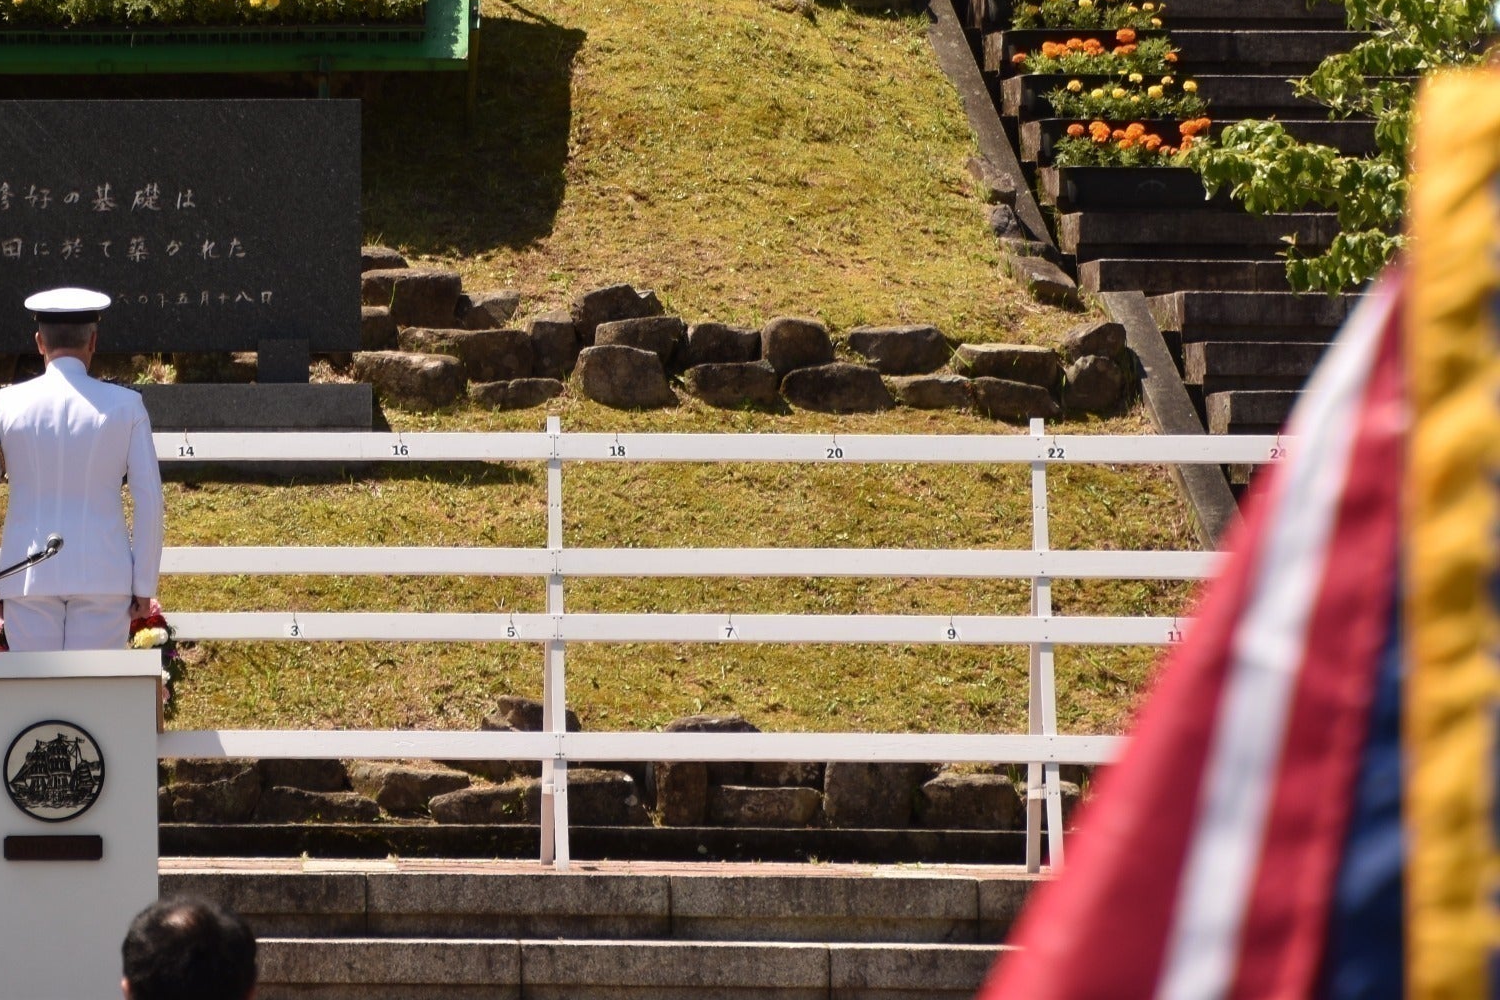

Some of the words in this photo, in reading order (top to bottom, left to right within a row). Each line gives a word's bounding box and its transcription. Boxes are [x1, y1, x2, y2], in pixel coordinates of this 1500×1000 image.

[178, 446, 195, 457] 14
[392, 445, 409, 456] 16
[609, 445, 626, 457] 18
[826, 447, 843, 459] 20
[1047, 447, 1065, 459] 22
[290, 625, 299, 637] 3
[507, 626, 516, 638] 5
[725, 627, 734, 638] 7
[947, 628, 957, 640] 9
[1167, 630, 1184, 642] 11
